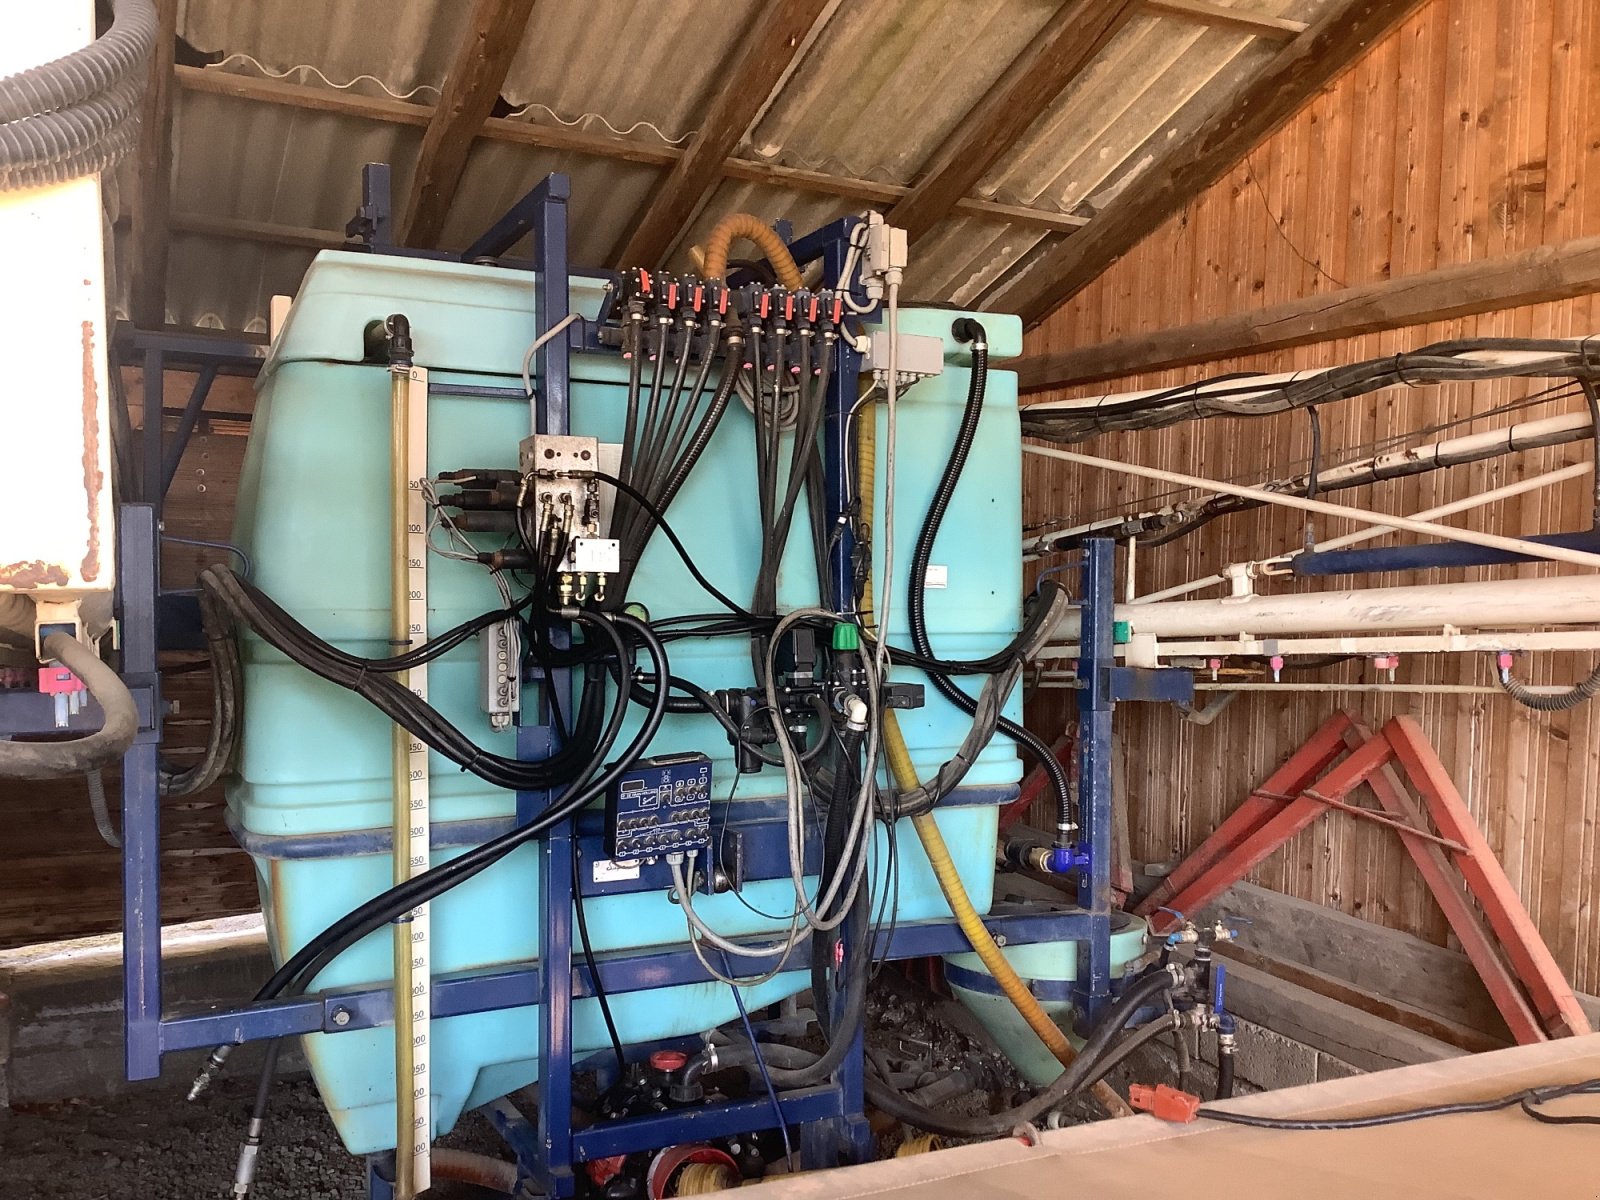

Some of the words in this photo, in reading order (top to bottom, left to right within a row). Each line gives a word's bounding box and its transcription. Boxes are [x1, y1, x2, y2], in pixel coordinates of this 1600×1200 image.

[412, 371, 418, 379] 0
[409, 480, 419, 489] 50
[408, 524, 421, 532] 100
[409, 558, 421, 567] 150
